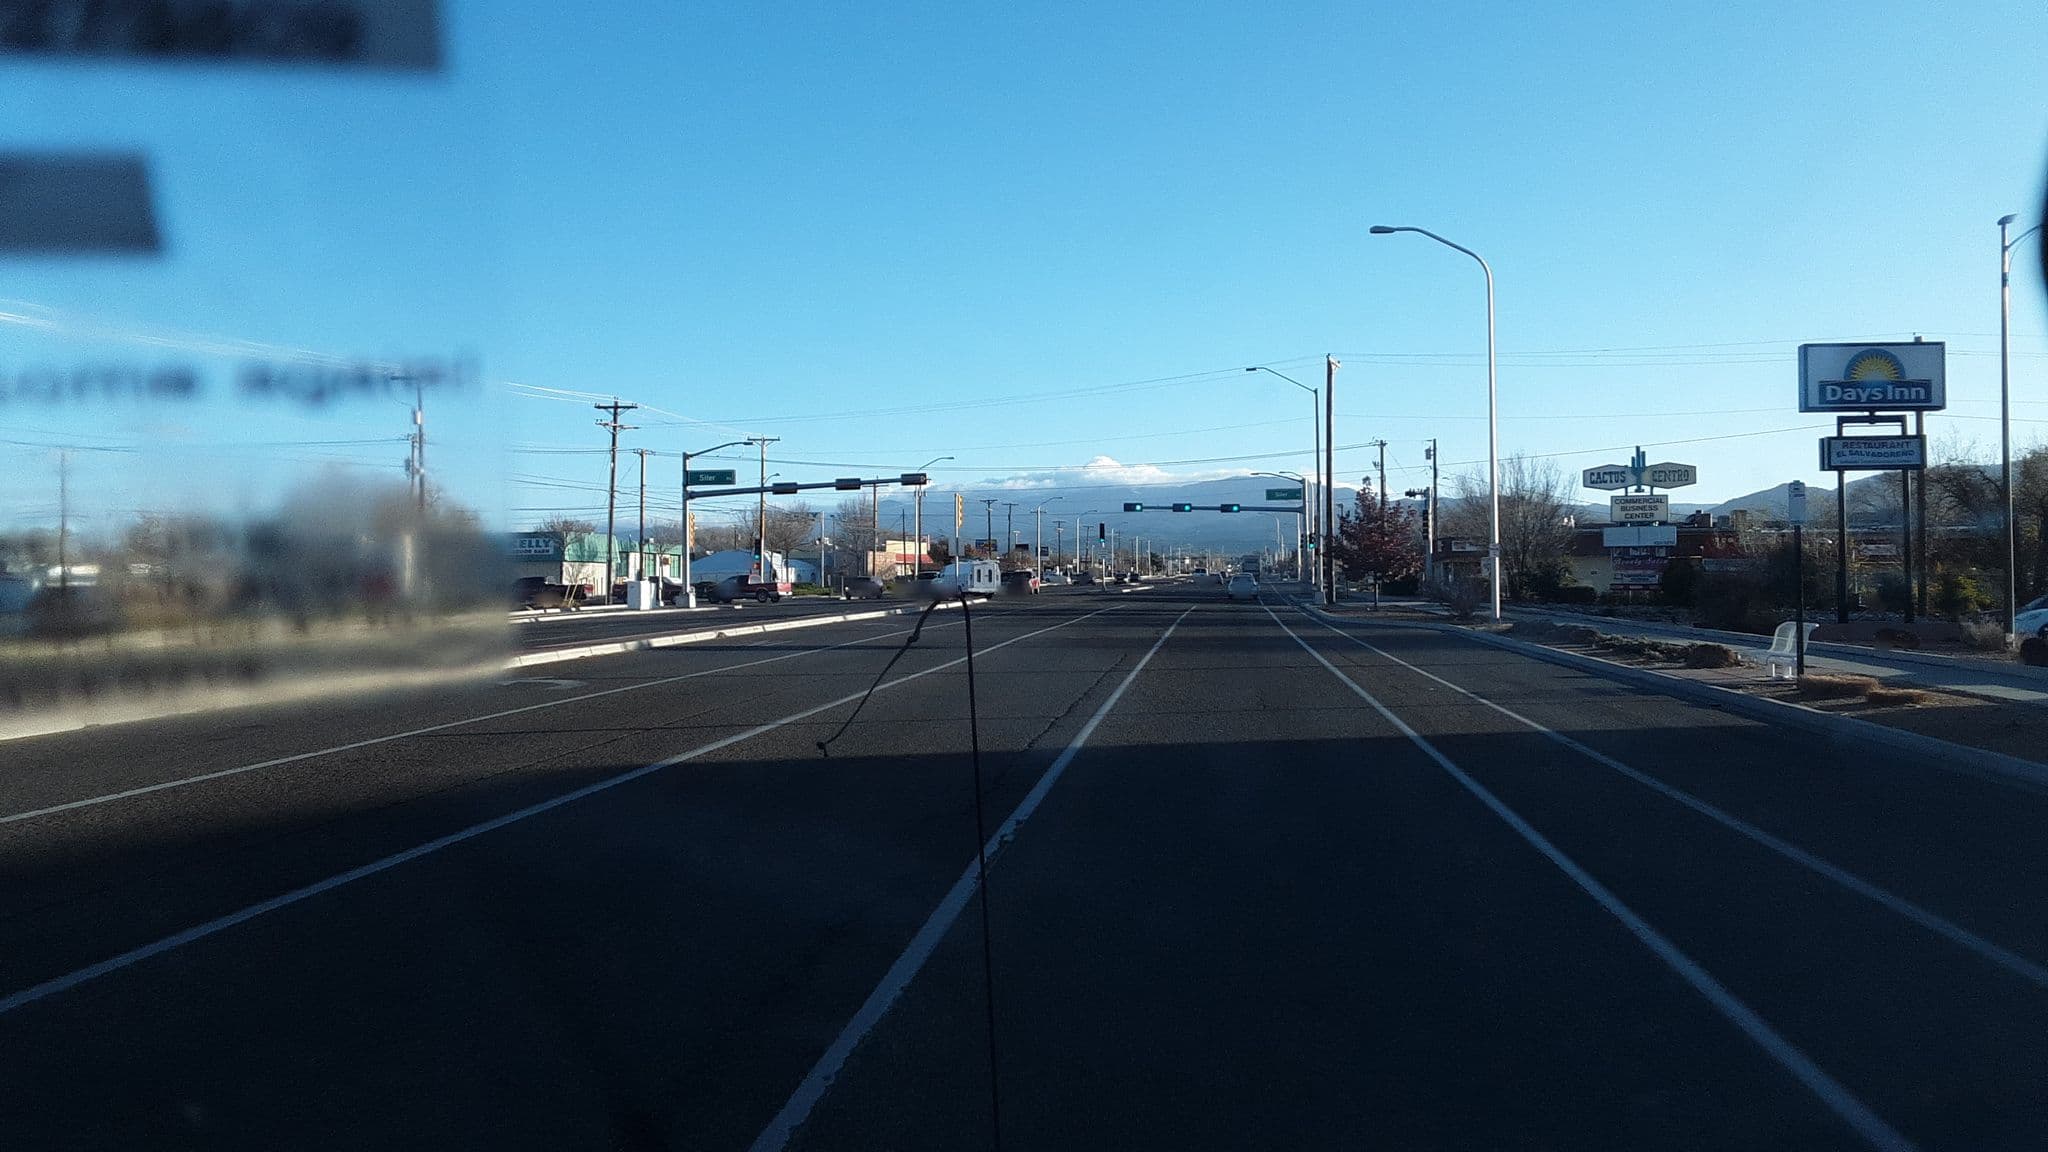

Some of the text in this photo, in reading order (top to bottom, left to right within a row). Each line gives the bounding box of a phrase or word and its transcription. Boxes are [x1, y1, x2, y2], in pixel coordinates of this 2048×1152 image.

[1825, 385, 1926, 402] Days Inn
[1841, 441, 1911, 449] RESTAURANT
[1589, 469, 1690, 484] CACTUS CENTRO
